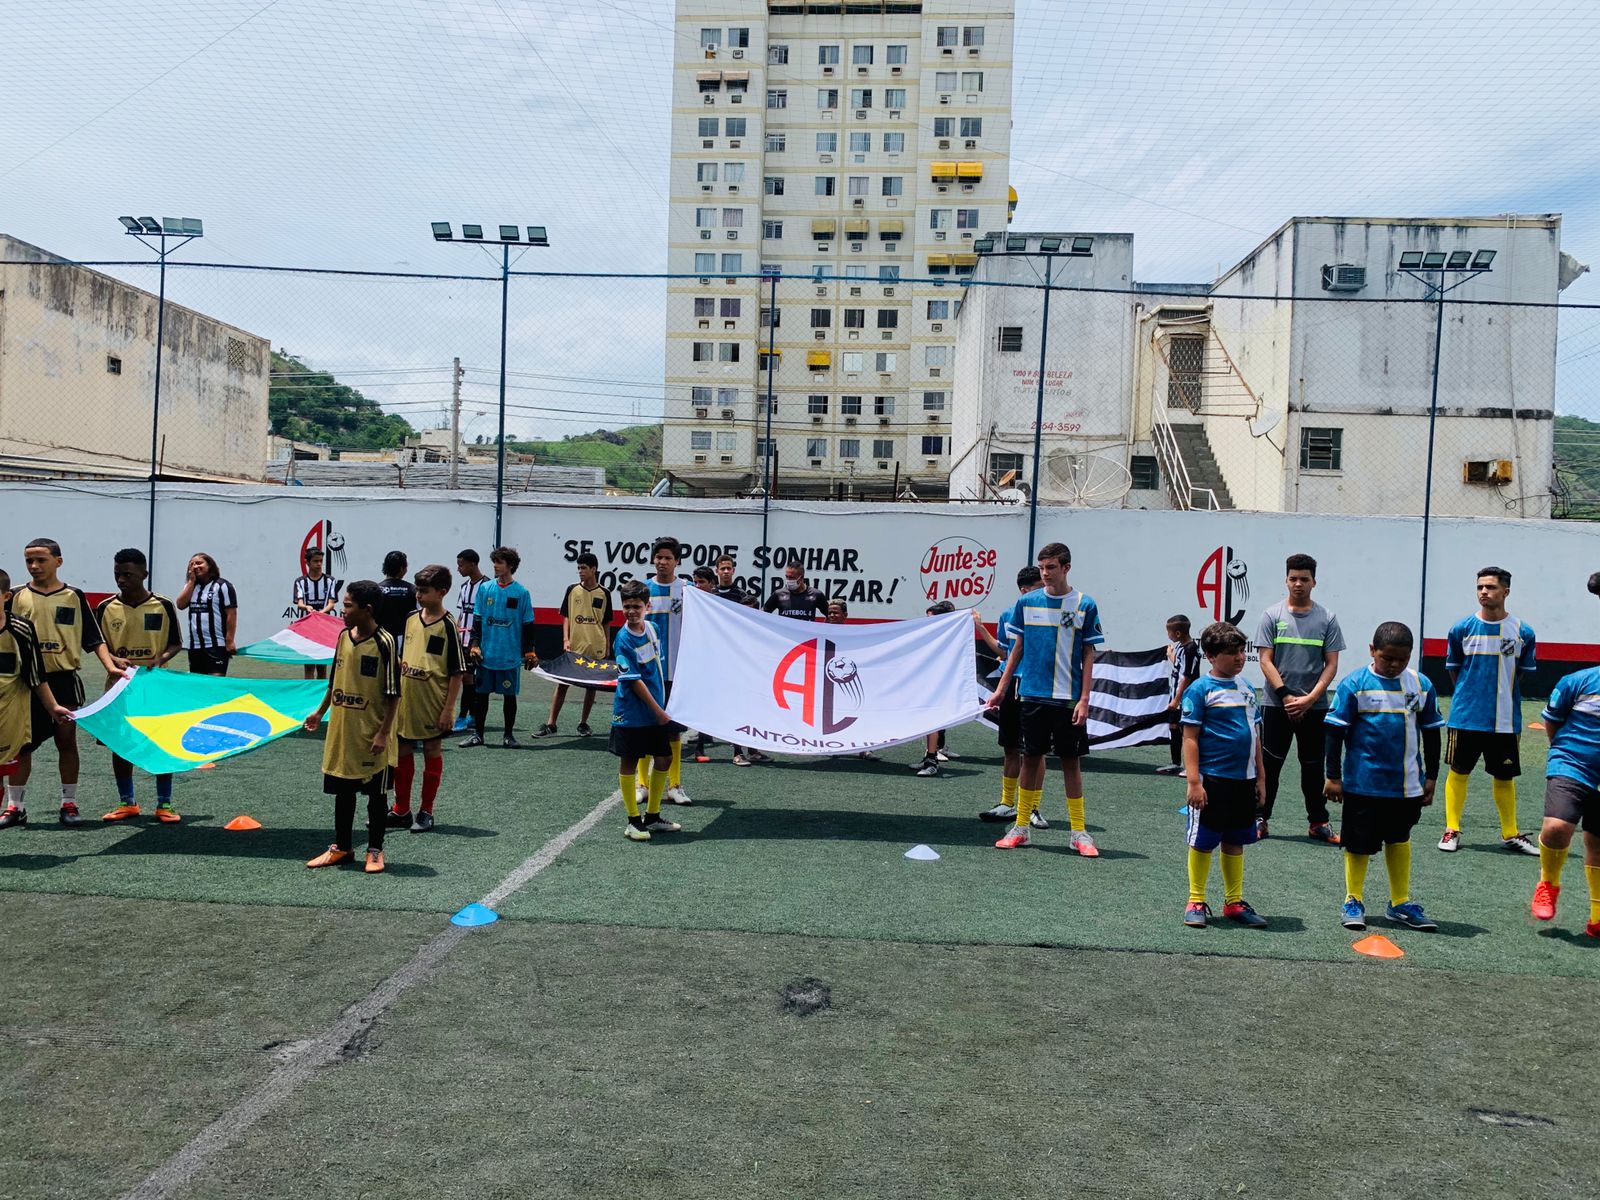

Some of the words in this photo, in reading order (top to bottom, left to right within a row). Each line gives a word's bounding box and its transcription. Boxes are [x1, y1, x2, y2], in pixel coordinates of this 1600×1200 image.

[1046, 371, 1073, 379] BELEZA
[1031, 421, 1081, 432] 264-3599
[604, 537, 664, 565] VOC
[752, 545, 864, 574] SONHAR,
[920, 545, 997, 574] Junte-se
[926, 580, 939, 600] A
[944, 571, 994, 600] NÓS!
[735, 724, 844, 749] ANTÔNIO
